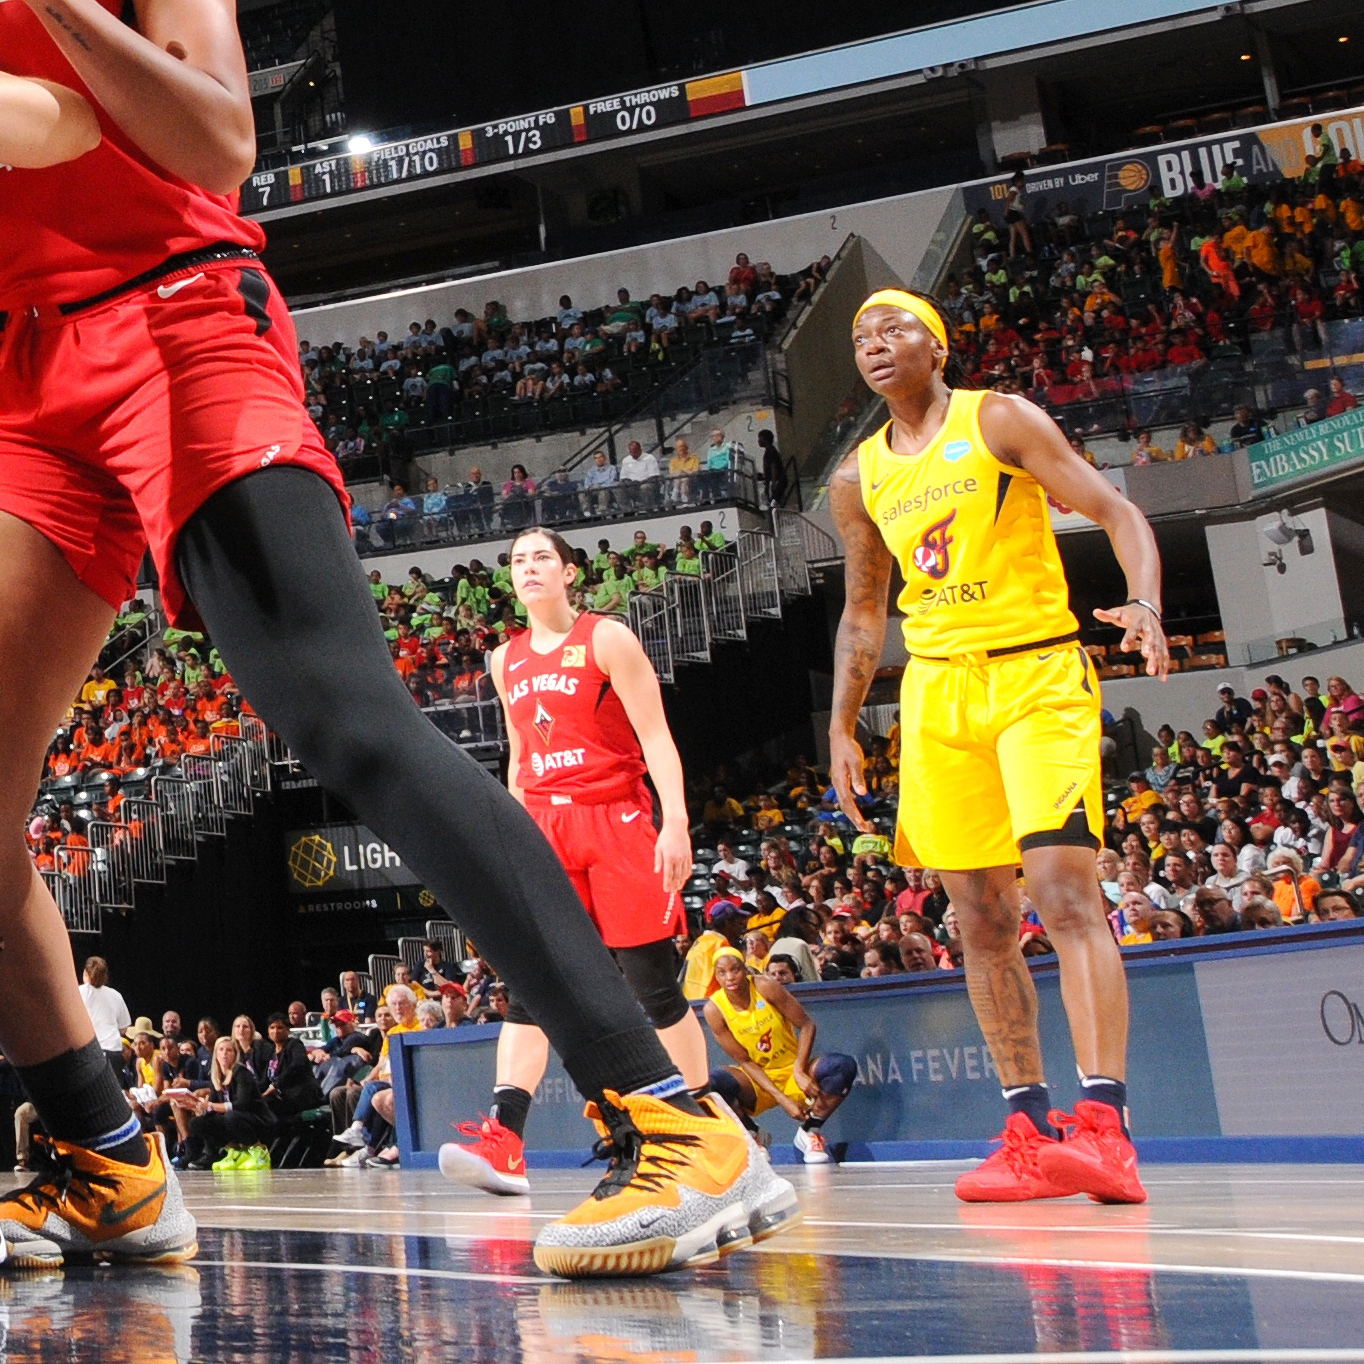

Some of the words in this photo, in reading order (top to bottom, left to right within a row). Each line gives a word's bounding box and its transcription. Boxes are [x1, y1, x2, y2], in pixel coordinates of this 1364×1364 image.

[589, 98, 621, 116] FREE
[623, 86, 680, 108] THROWS
[485, 116, 536, 137] 3-POINT
[538, 112, 556, 126] FG
[616, 105, 656, 130] 0/0
[373, 144, 406, 162] FIELD
[408, 136, 448, 154] GOALS
[504, 130, 542, 154] 1/3
[314, 160, 337, 174] AST
[388, 152, 438, 179] 1/10
[1252, 138, 1300, 175] AND
[252, 173, 275, 186] REB
[322, 174, 331, 193] 1
[1026, 179, 1054, 194] DRIVEN
[1054, 178, 1064, 188] BY
[1068, 172, 1099, 186] Uber
[258, 186, 270, 206] 7
[1252, 438, 1330, 484] EMBASSY
[883, 478, 978, 526] salesforce
[936, 580, 988, 608] AT&T
[508, 680, 528, 705] LAS
[532, 674, 580, 695] VEGAS
[545, 748, 586, 770] AT&T
[344, 842, 400, 870] LIGH
[308, 900, 378, 913] RESTROOMS
[910, 1044, 1001, 1084] FEVER
